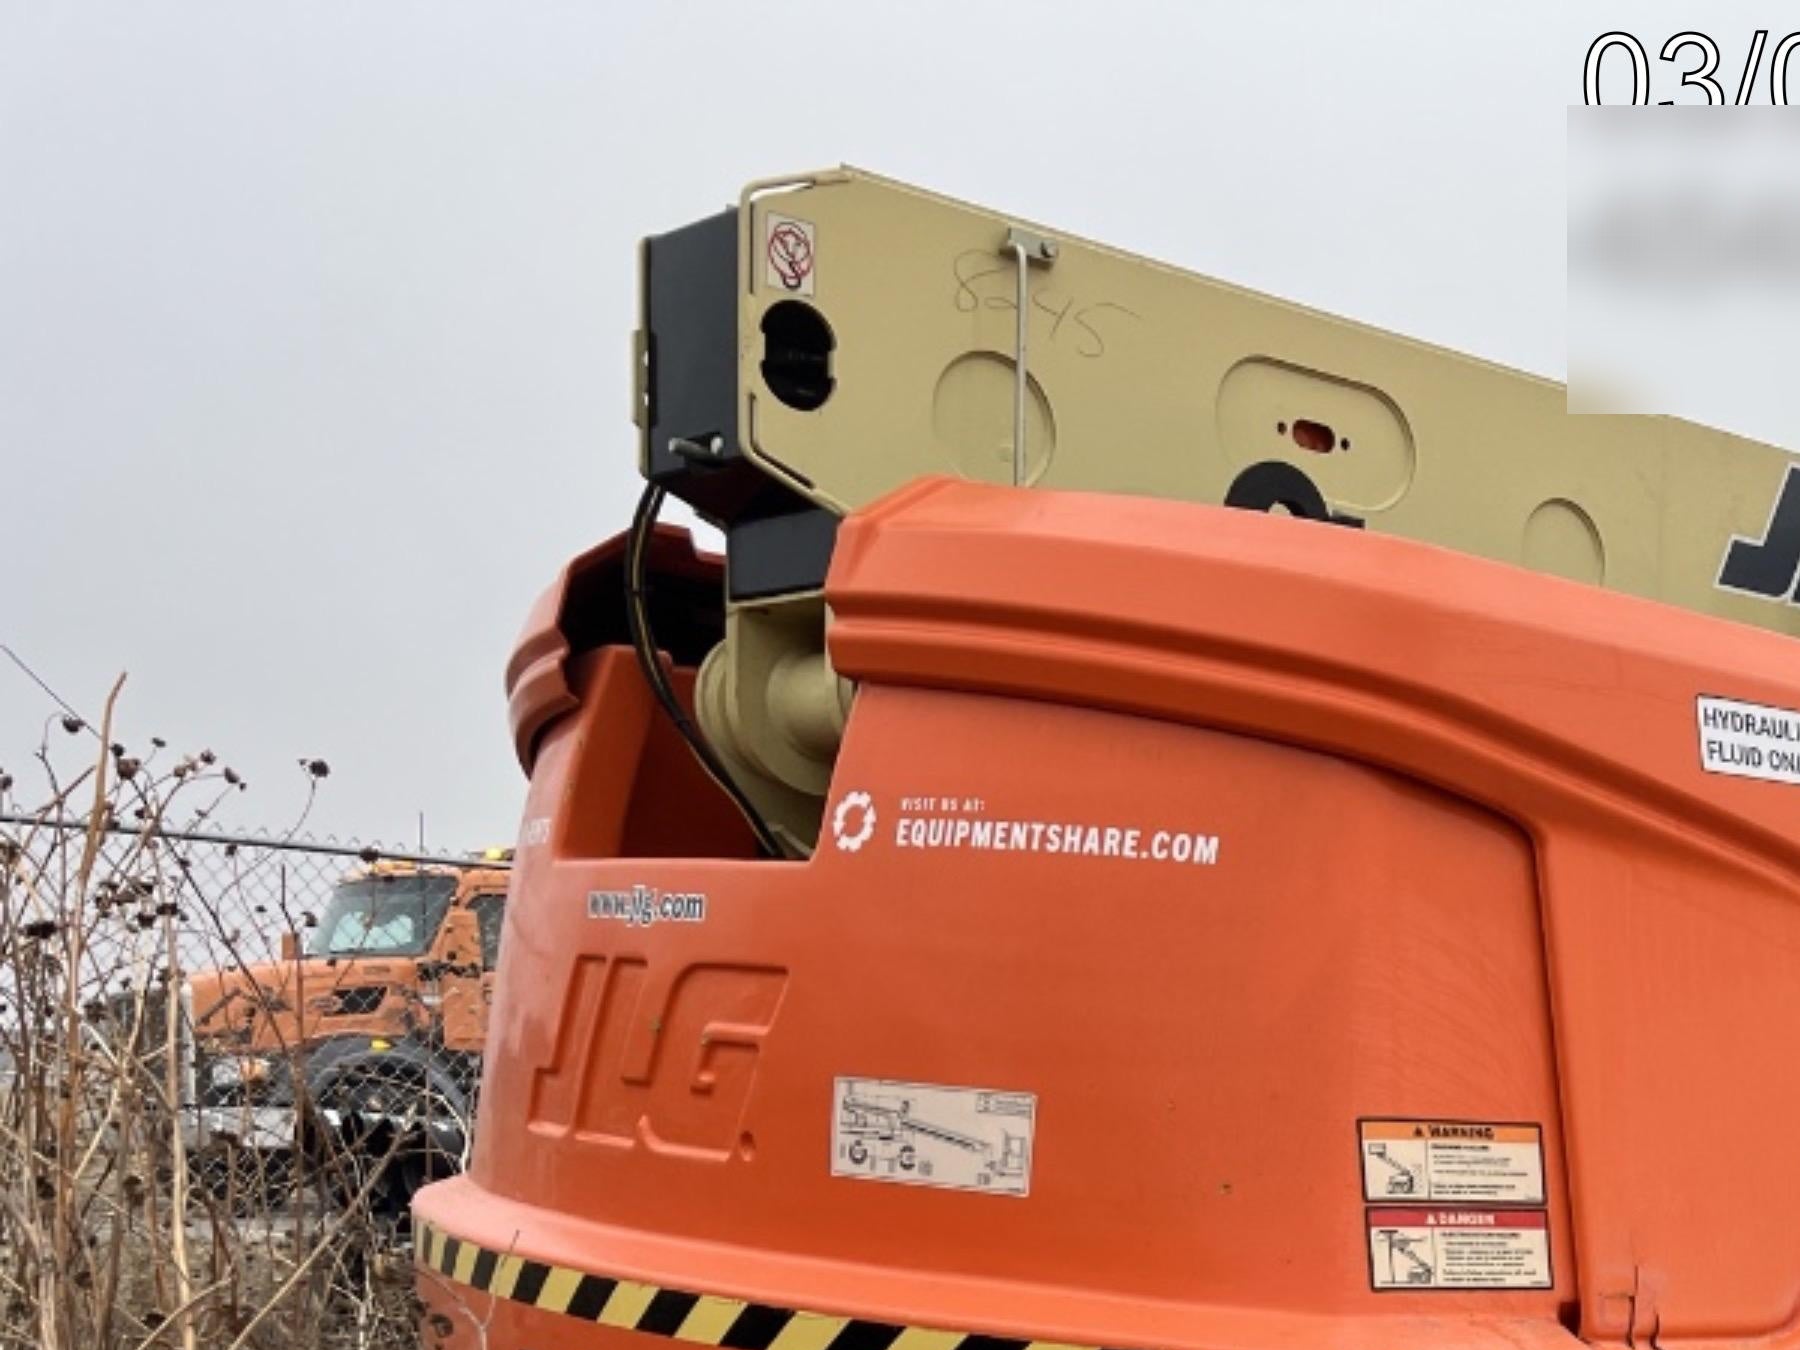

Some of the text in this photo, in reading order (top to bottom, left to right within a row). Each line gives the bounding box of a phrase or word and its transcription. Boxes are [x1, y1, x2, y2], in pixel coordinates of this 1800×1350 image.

[1706, 739, 1763, 768] FLUID
[895, 818, 1219, 866] EQUIPMENTSHARE.COM
[588, 884, 706, 928] www.jlg.com
